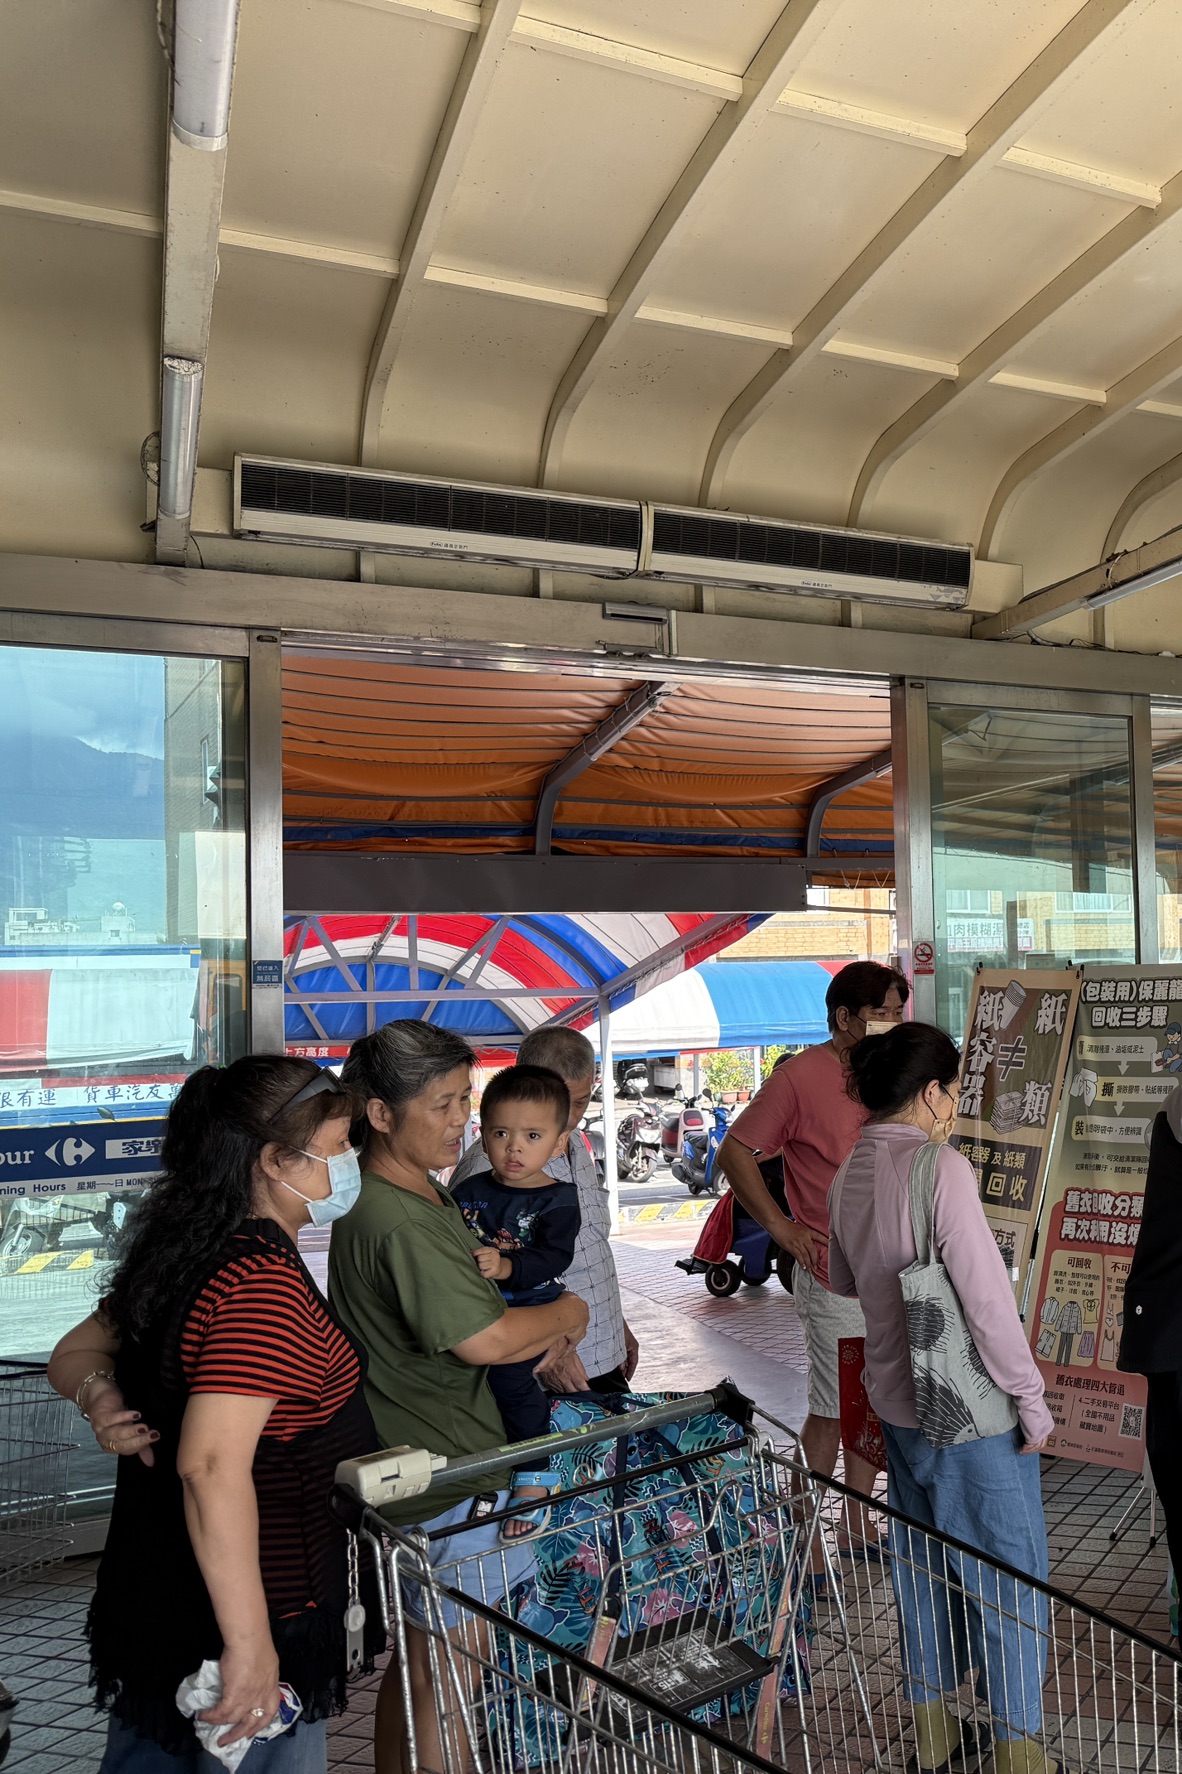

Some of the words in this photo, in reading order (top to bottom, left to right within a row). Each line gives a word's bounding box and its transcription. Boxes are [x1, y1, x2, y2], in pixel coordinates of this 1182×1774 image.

[1091, 1005, 1168, 1027] 回收三步驟
[1101, 1082, 1115, 1097] 撕
[1075, 1120, 1085, 1136] 裝
[991, 1151, 1001, 1165] 及
[1003, 1150, 1026, 1170] 紙類
[33, 1183, 66, 1193] Hours
[1067, 1256, 1092, 1269] 可回收
[1055, 1373, 1125, 1396] 舊衣處理四大管道
